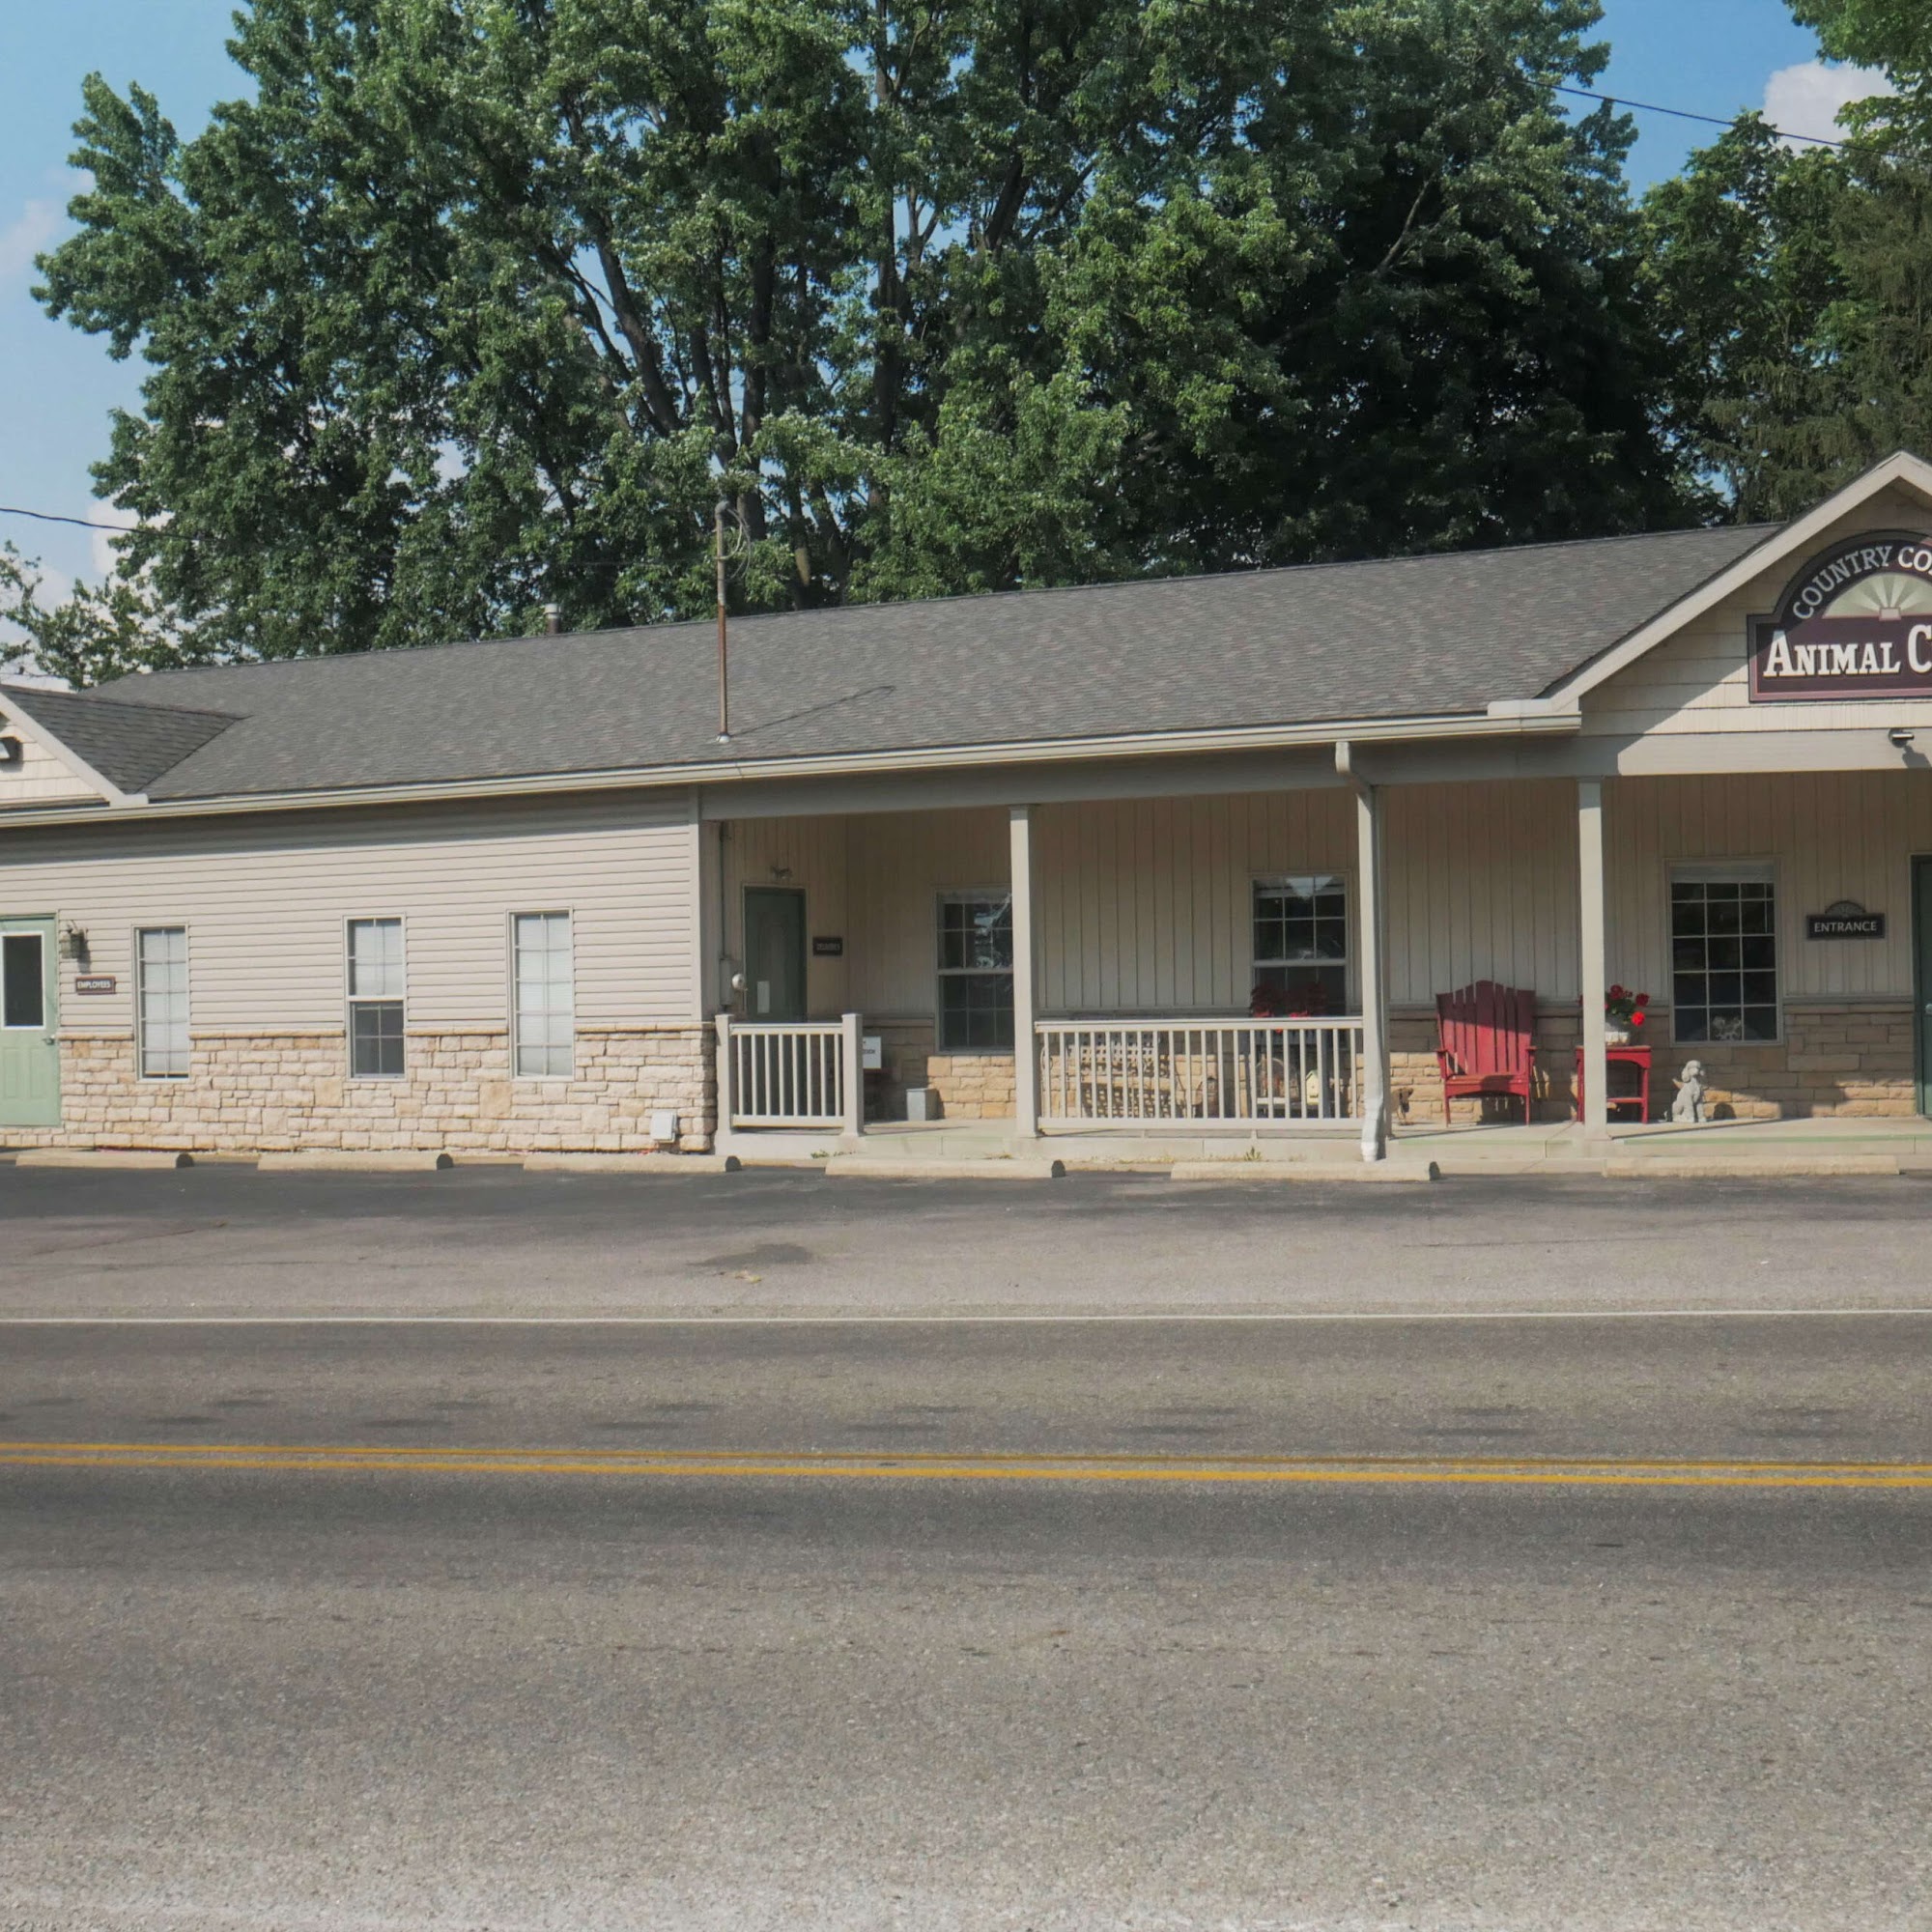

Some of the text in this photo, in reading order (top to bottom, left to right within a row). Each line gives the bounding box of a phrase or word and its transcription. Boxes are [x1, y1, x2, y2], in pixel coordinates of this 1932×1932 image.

[1793, 546, 1932, 619] COUNTRY CO
[1763, 630, 1901, 677] ANIMAL
[1814, 921, 1877, 933] ENTRANCE
[76, 980, 111, 989] EMPLOYEES
